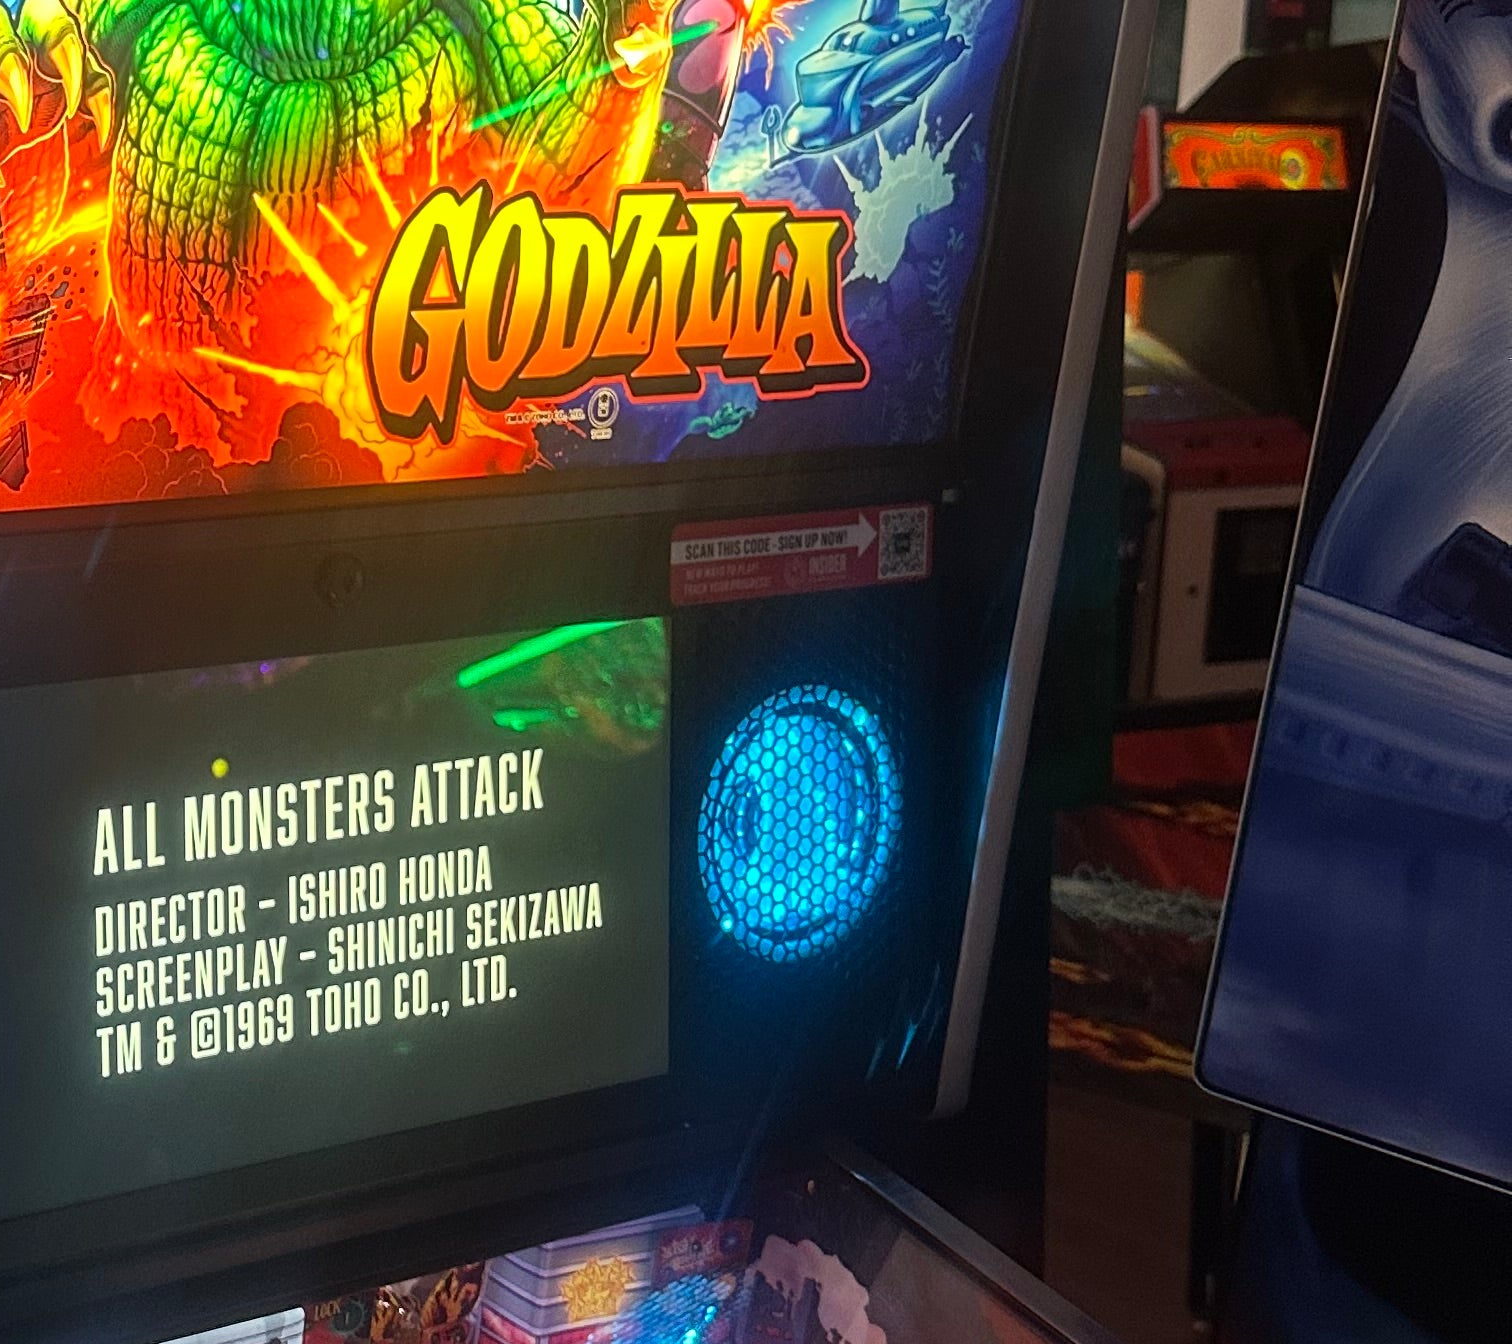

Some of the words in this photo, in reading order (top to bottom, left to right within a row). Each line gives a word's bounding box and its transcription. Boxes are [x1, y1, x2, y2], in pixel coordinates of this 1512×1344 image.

[373, 181, 860, 439] GODZILLA
[684, 543, 715, 561] SCAN
[717, 540, 741, 558] THIS
[743, 537, 772, 555] CODE
[778, 534, 804, 553] SIGN
[805, 532, 819, 548] UP
[820, 529, 849, 547] NOW!
[807, 554, 848, 576] INSIDER
[93, 801, 166, 877] ALL
[182, 768, 395, 862] MONSTERS
[409, 747, 545, 828] ATTACK
[94, 883, 246, 958] DIRECTOR
[287, 860, 387, 925] ISHIRO
[397, 843, 493, 906] HONDA
[95, 935, 289, 1017] SCREENPLAY
[327, 913, 455, 976] SHINICHI
[465, 881, 604, 952] SEKIZAWA
[96, 1024, 143, 1078] TM
[155, 1017, 177, 1066] &
[189, 993, 296, 1061] ©1969
[305, 978, 382, 1037] TOHO
[392, 969, 452, 1019] CO.,
[459, 954, 519, 1008] LTD.
[313, 1297, 342, 1322] LOCK
